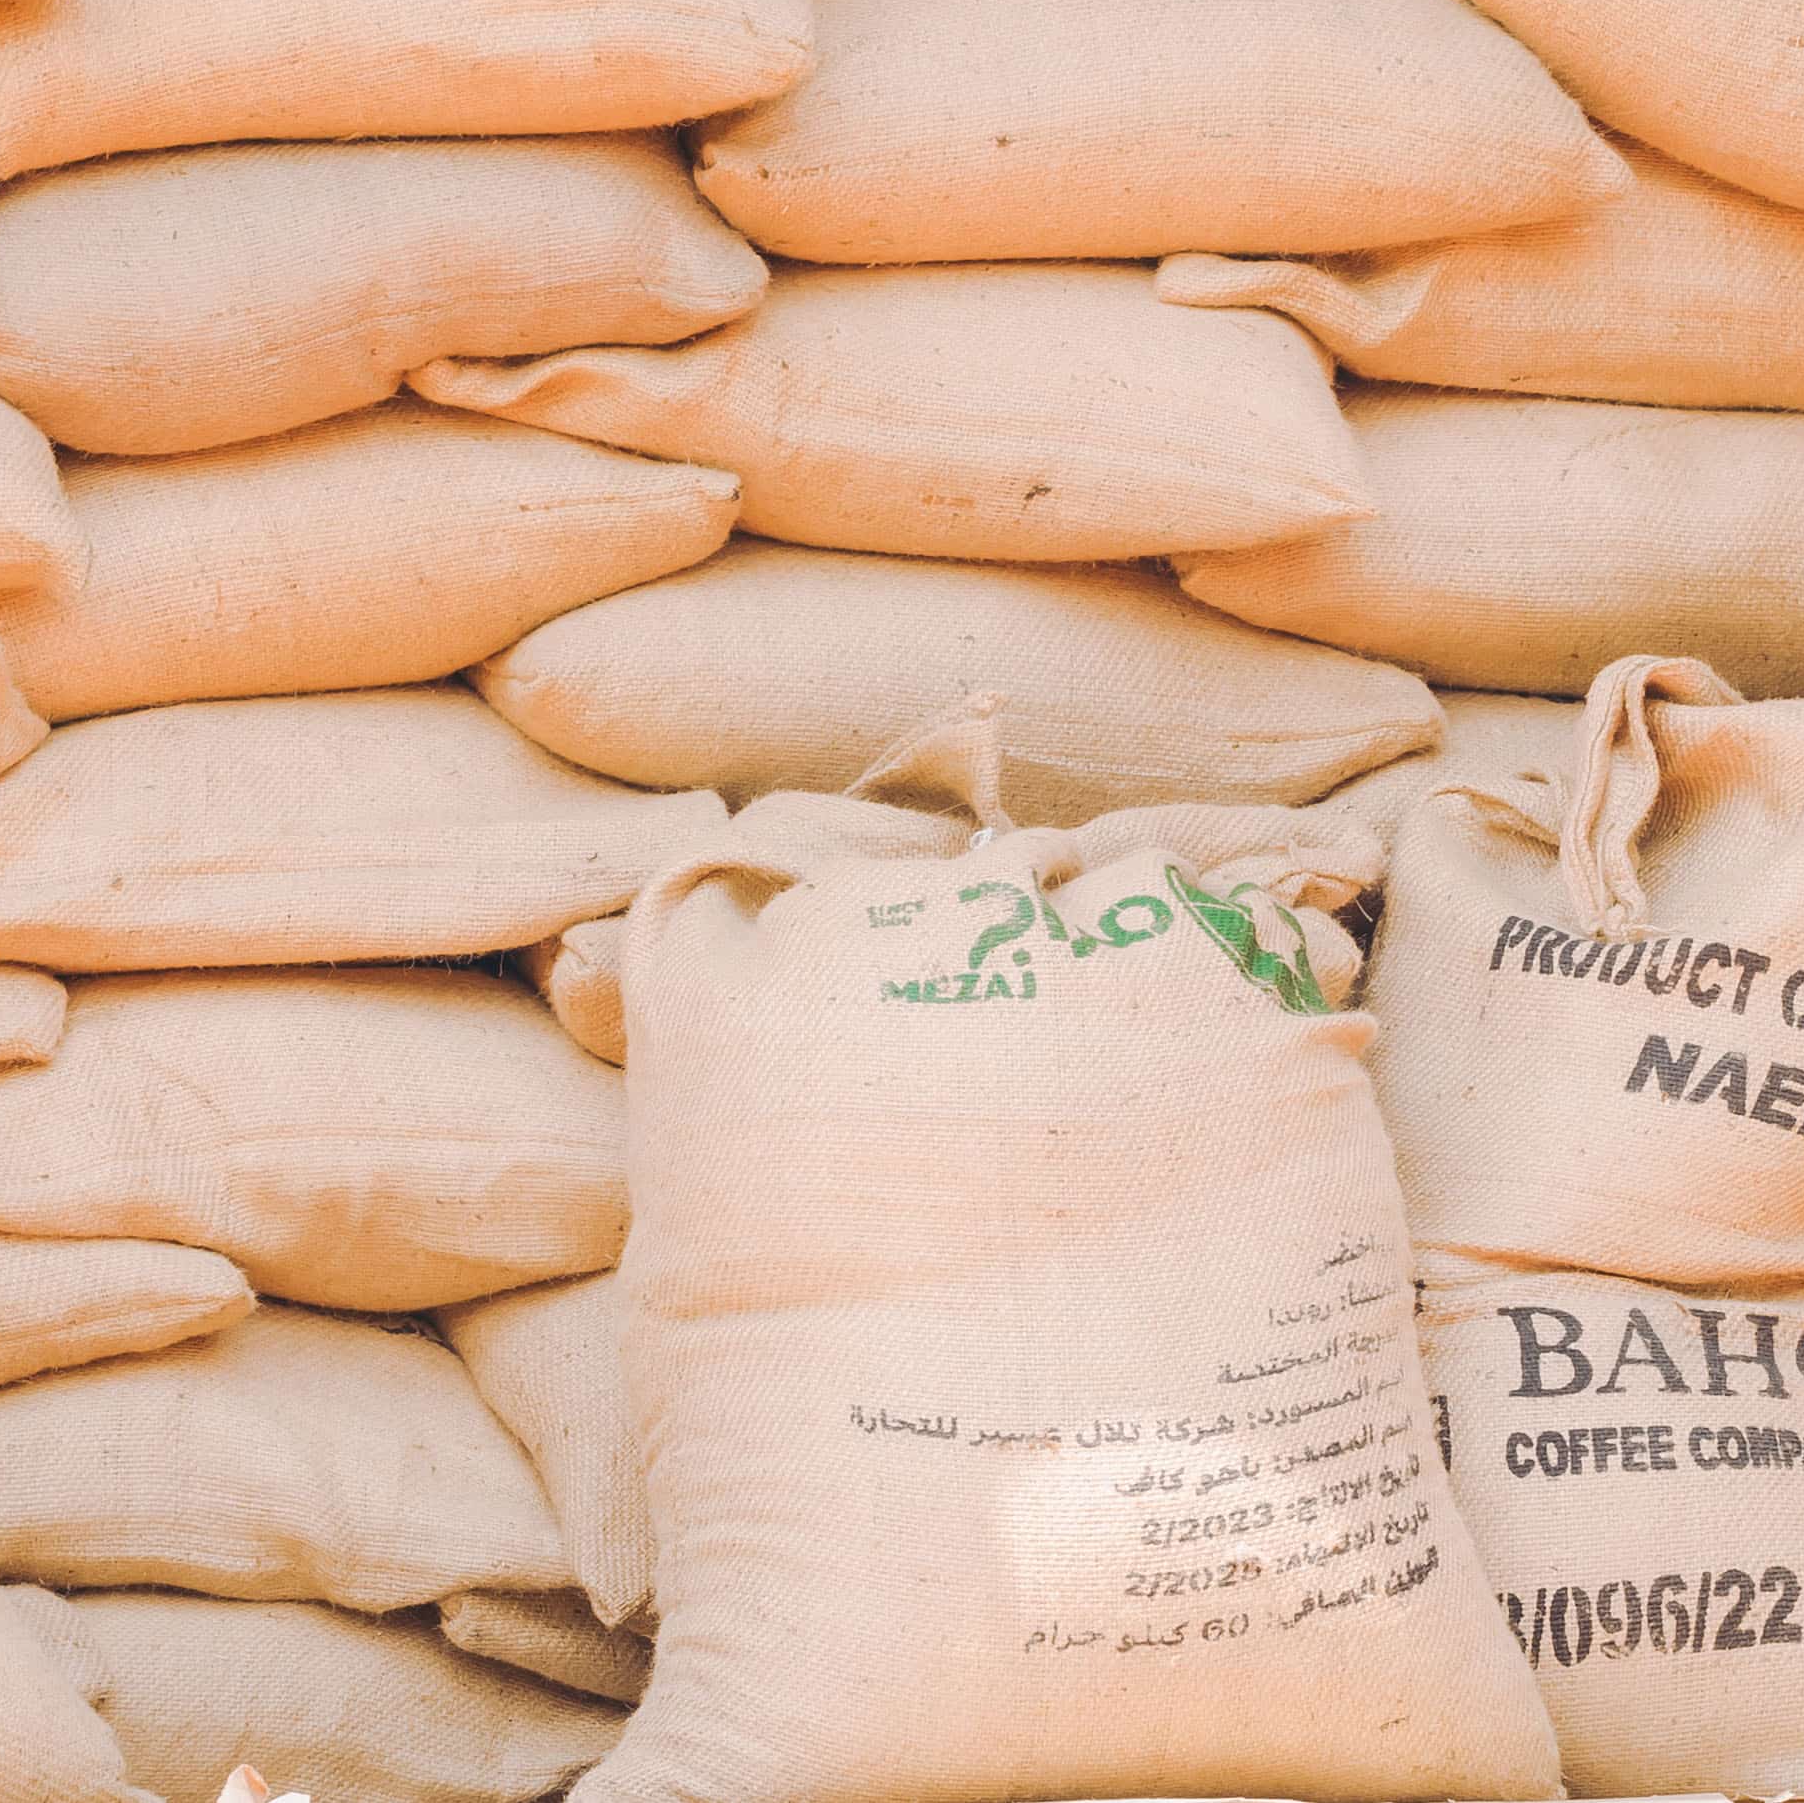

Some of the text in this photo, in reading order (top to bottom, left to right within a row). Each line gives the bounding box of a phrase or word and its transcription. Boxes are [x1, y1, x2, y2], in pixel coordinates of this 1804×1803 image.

[1489, 915, 1772, 1016] PRODUCT
[1505, 1425, 1679, 1480] COFFEE
[1140, 1501, 1276, 1548] 2/2023
[1123, 1555, 1263, 1600] 2/2025
[1201, 1612, 1251, 1643] 60
